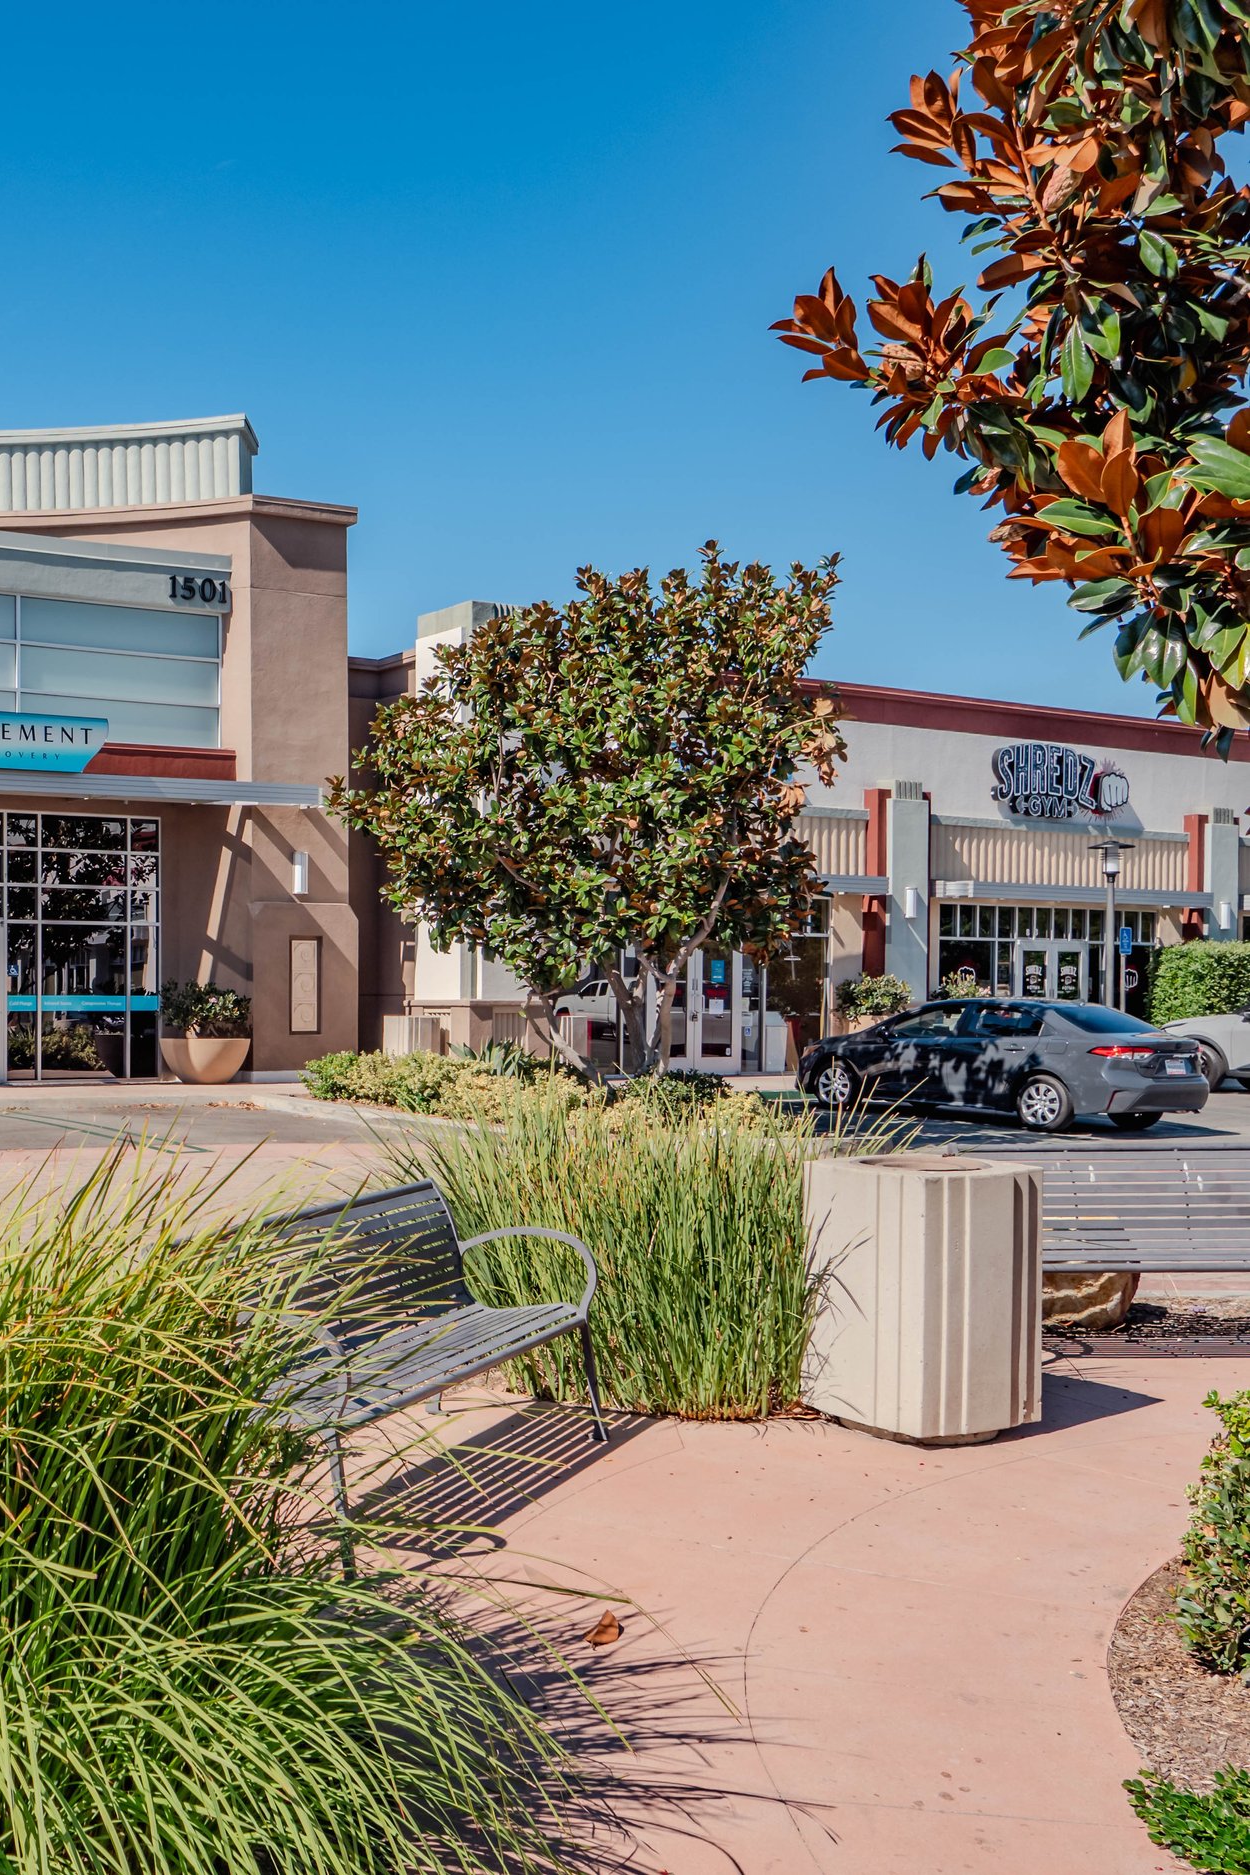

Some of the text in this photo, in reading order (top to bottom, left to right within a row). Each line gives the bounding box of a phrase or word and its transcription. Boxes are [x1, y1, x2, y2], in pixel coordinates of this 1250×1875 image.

[169, 574, 227, 603] 1501
[998, 743, 1096, 810] SHREDZ
[1028, 795, 1068, 818] GYM
